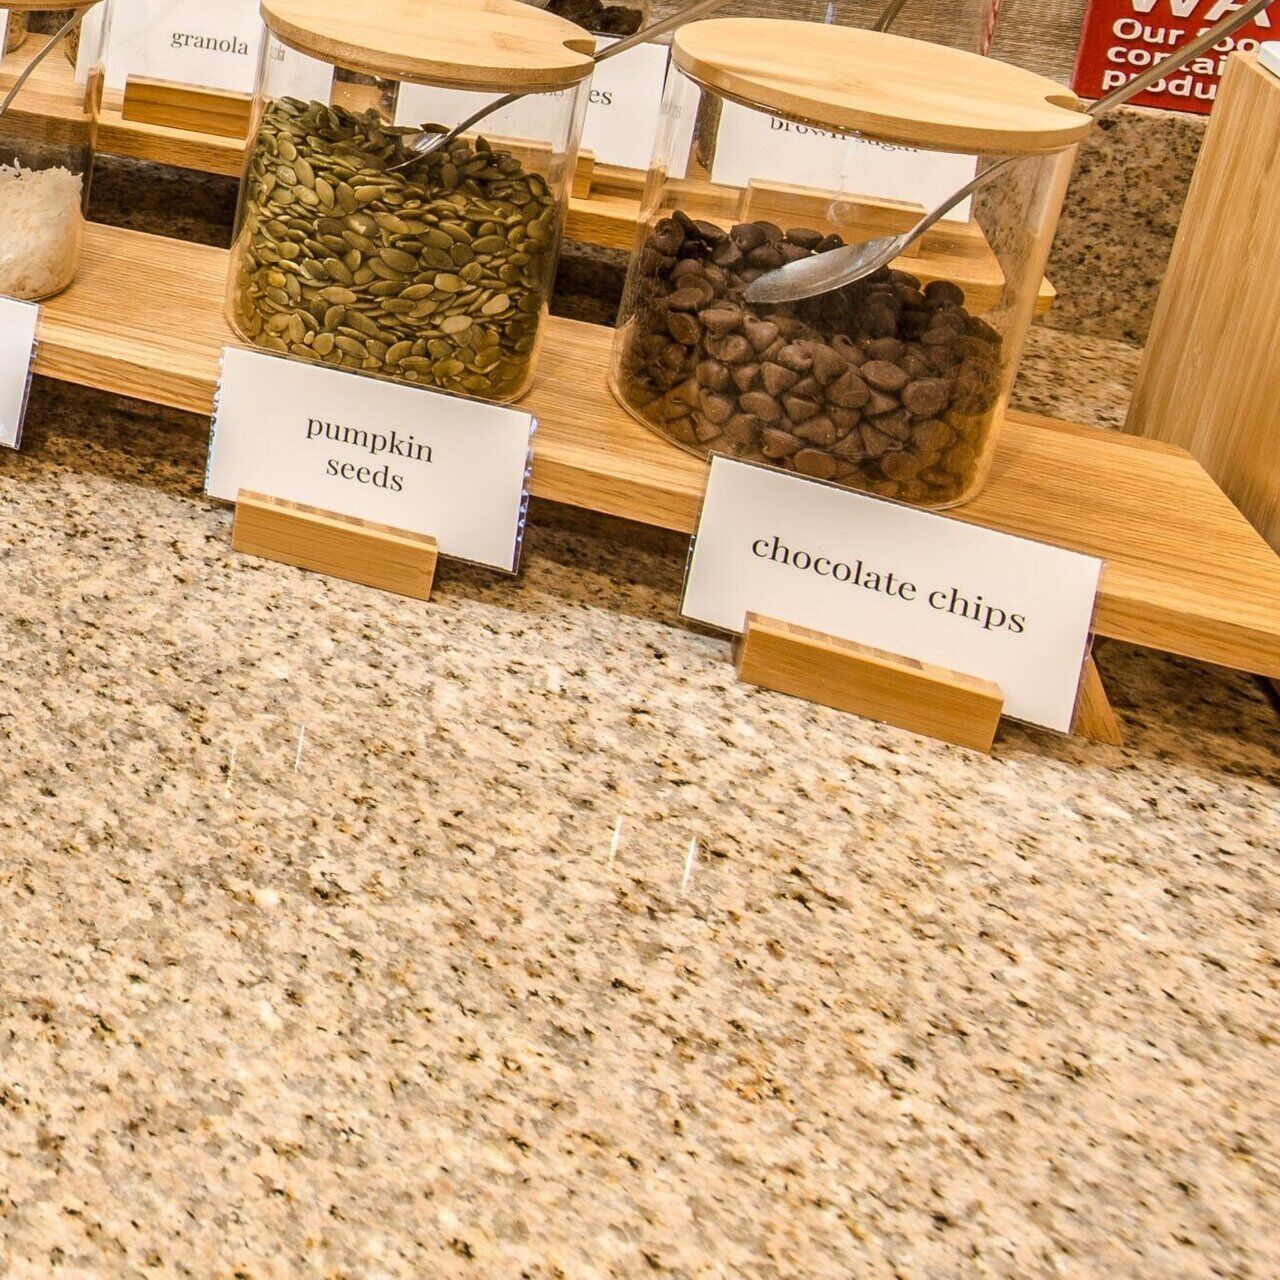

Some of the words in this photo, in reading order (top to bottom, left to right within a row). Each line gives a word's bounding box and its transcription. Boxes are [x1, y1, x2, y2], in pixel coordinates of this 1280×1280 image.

[170, 32, 248, 55] granola
[1112, 18, 1185, 45] Our
[306, 418, 433, 463] pumpkin
[326, 458, 403, 492] seeds
[752, 535, 917, 601] chocolate
[928, 588, 1026, 634] chips
